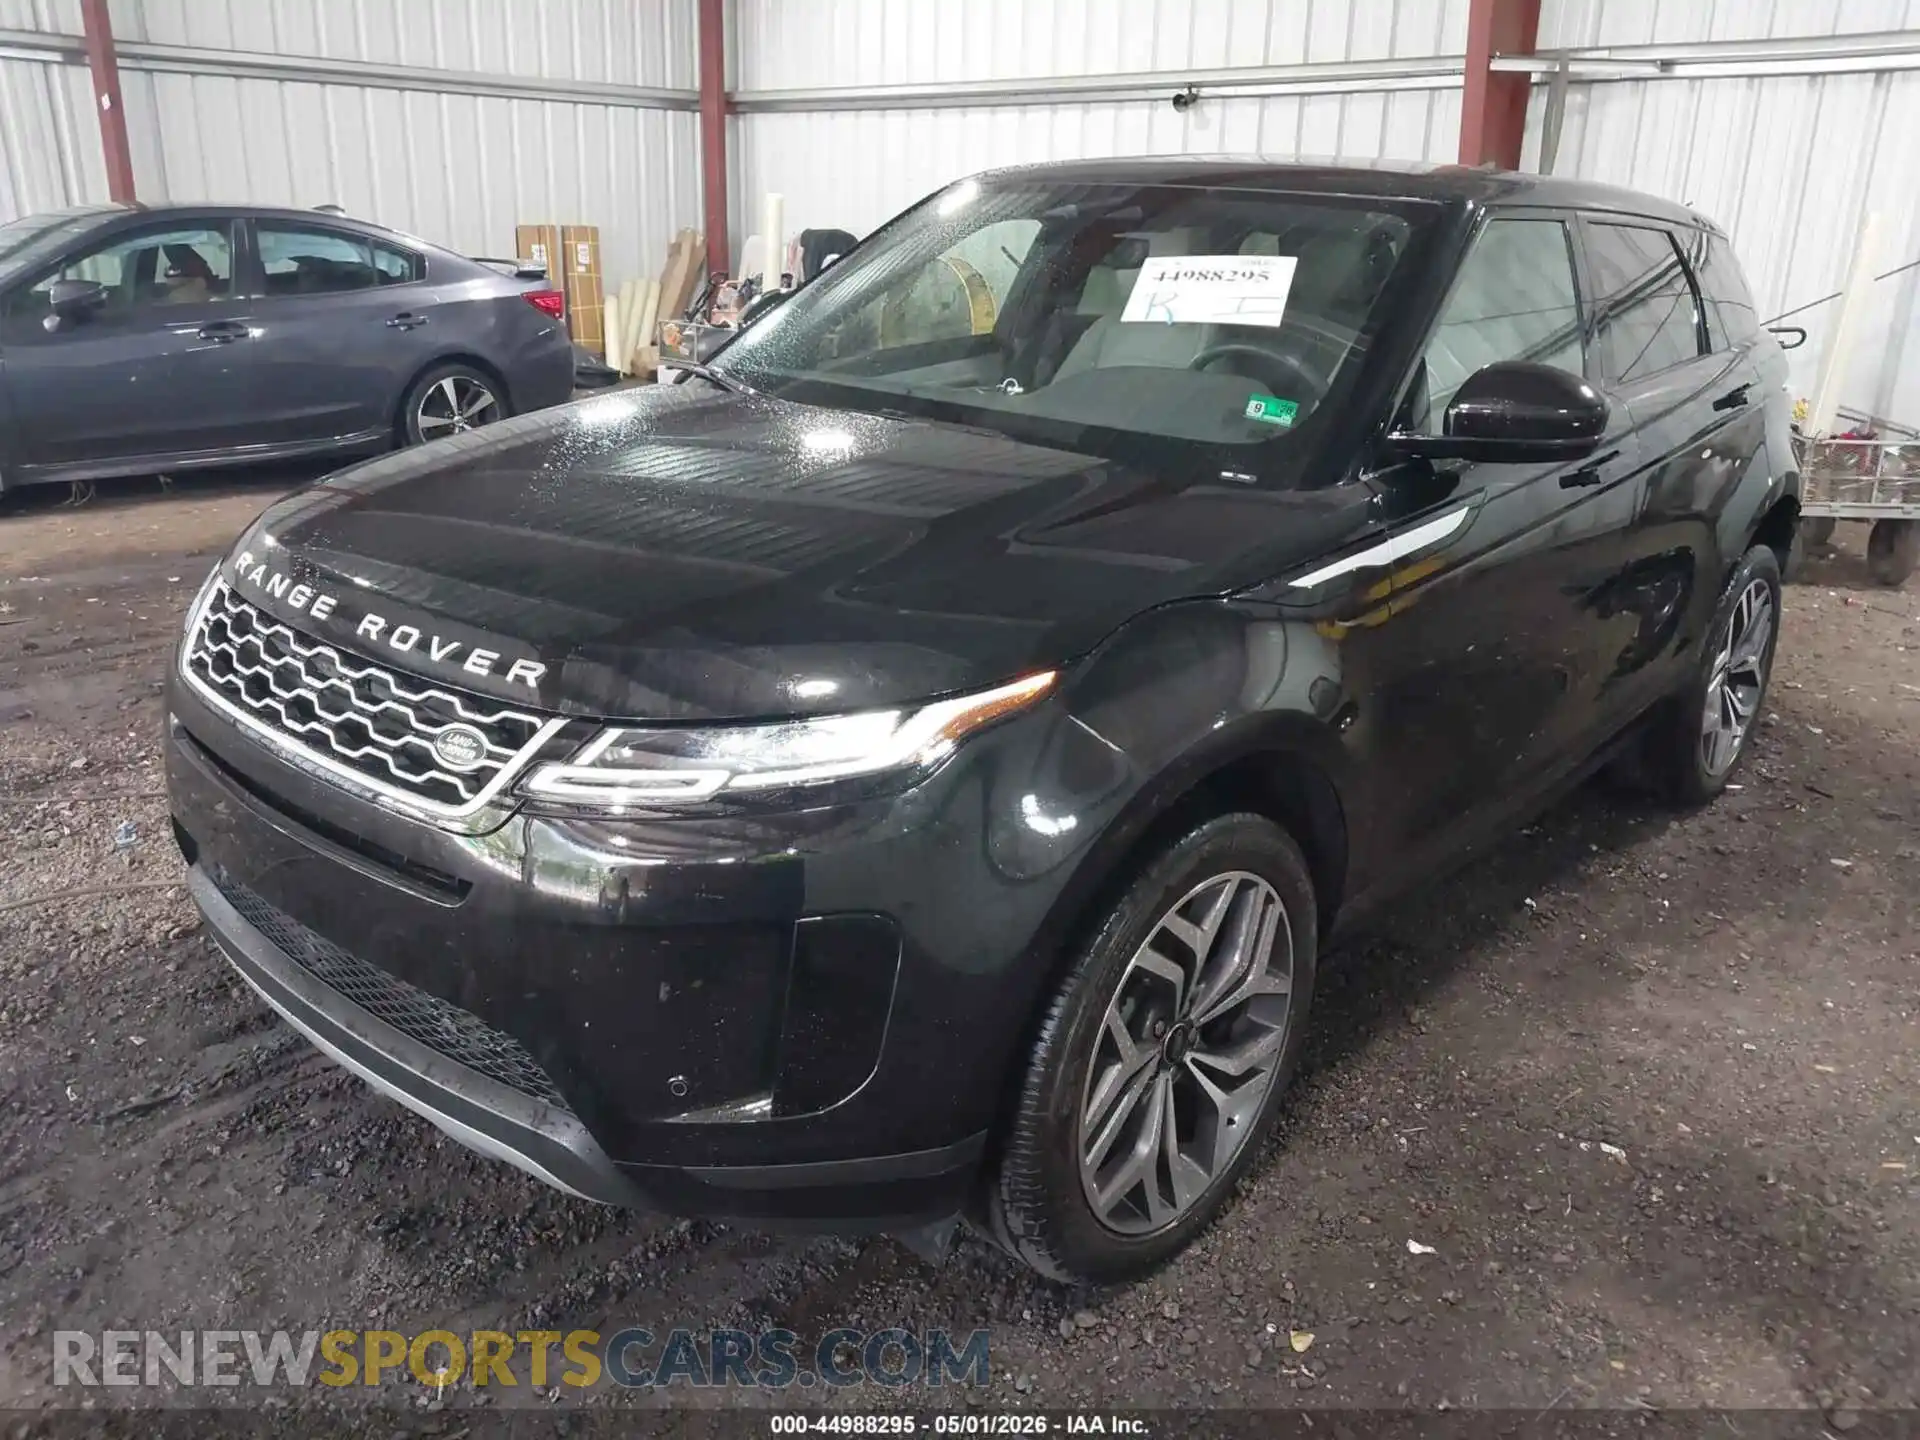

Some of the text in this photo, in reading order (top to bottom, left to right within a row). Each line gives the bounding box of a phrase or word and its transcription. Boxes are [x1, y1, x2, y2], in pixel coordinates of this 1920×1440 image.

[1153, 269, 1272, 283] 44988295
[234, 552, 546, 688] RANGE ROVER
[446, 733, 474, 747] LAND
[443, 743, 476, 760] ROVER
